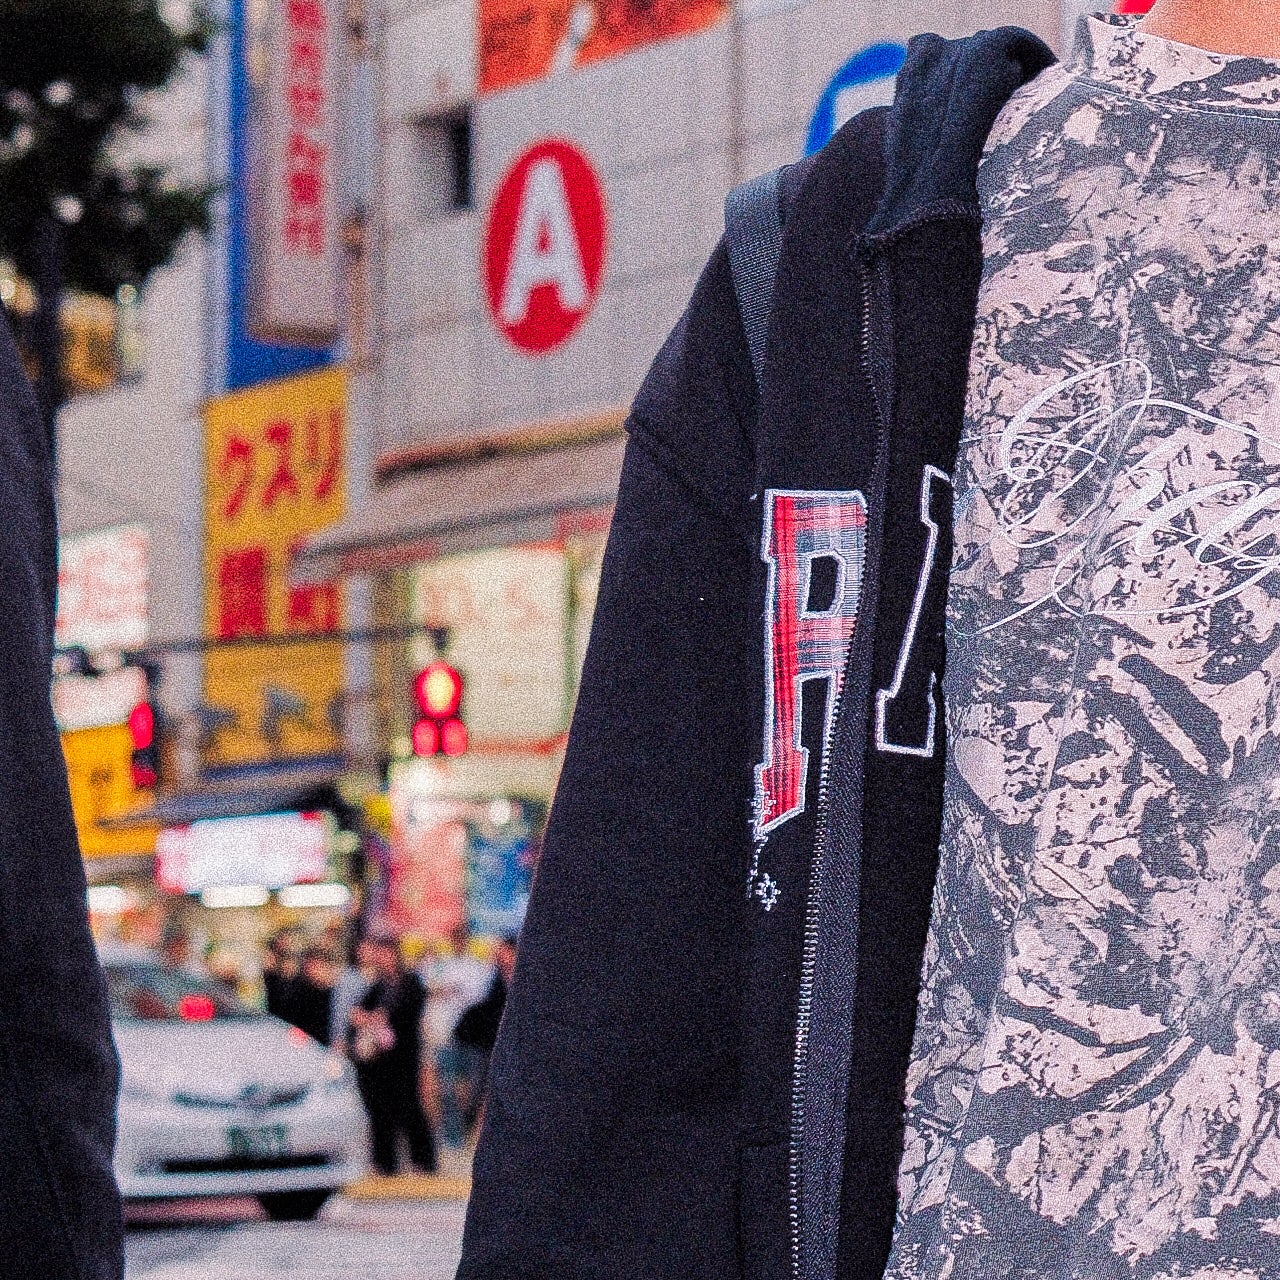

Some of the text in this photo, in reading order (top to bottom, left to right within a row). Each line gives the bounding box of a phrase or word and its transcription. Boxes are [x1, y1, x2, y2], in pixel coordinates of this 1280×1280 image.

[501, 156, 588, 324] A
[218, 405, 345, 521] クスリ
